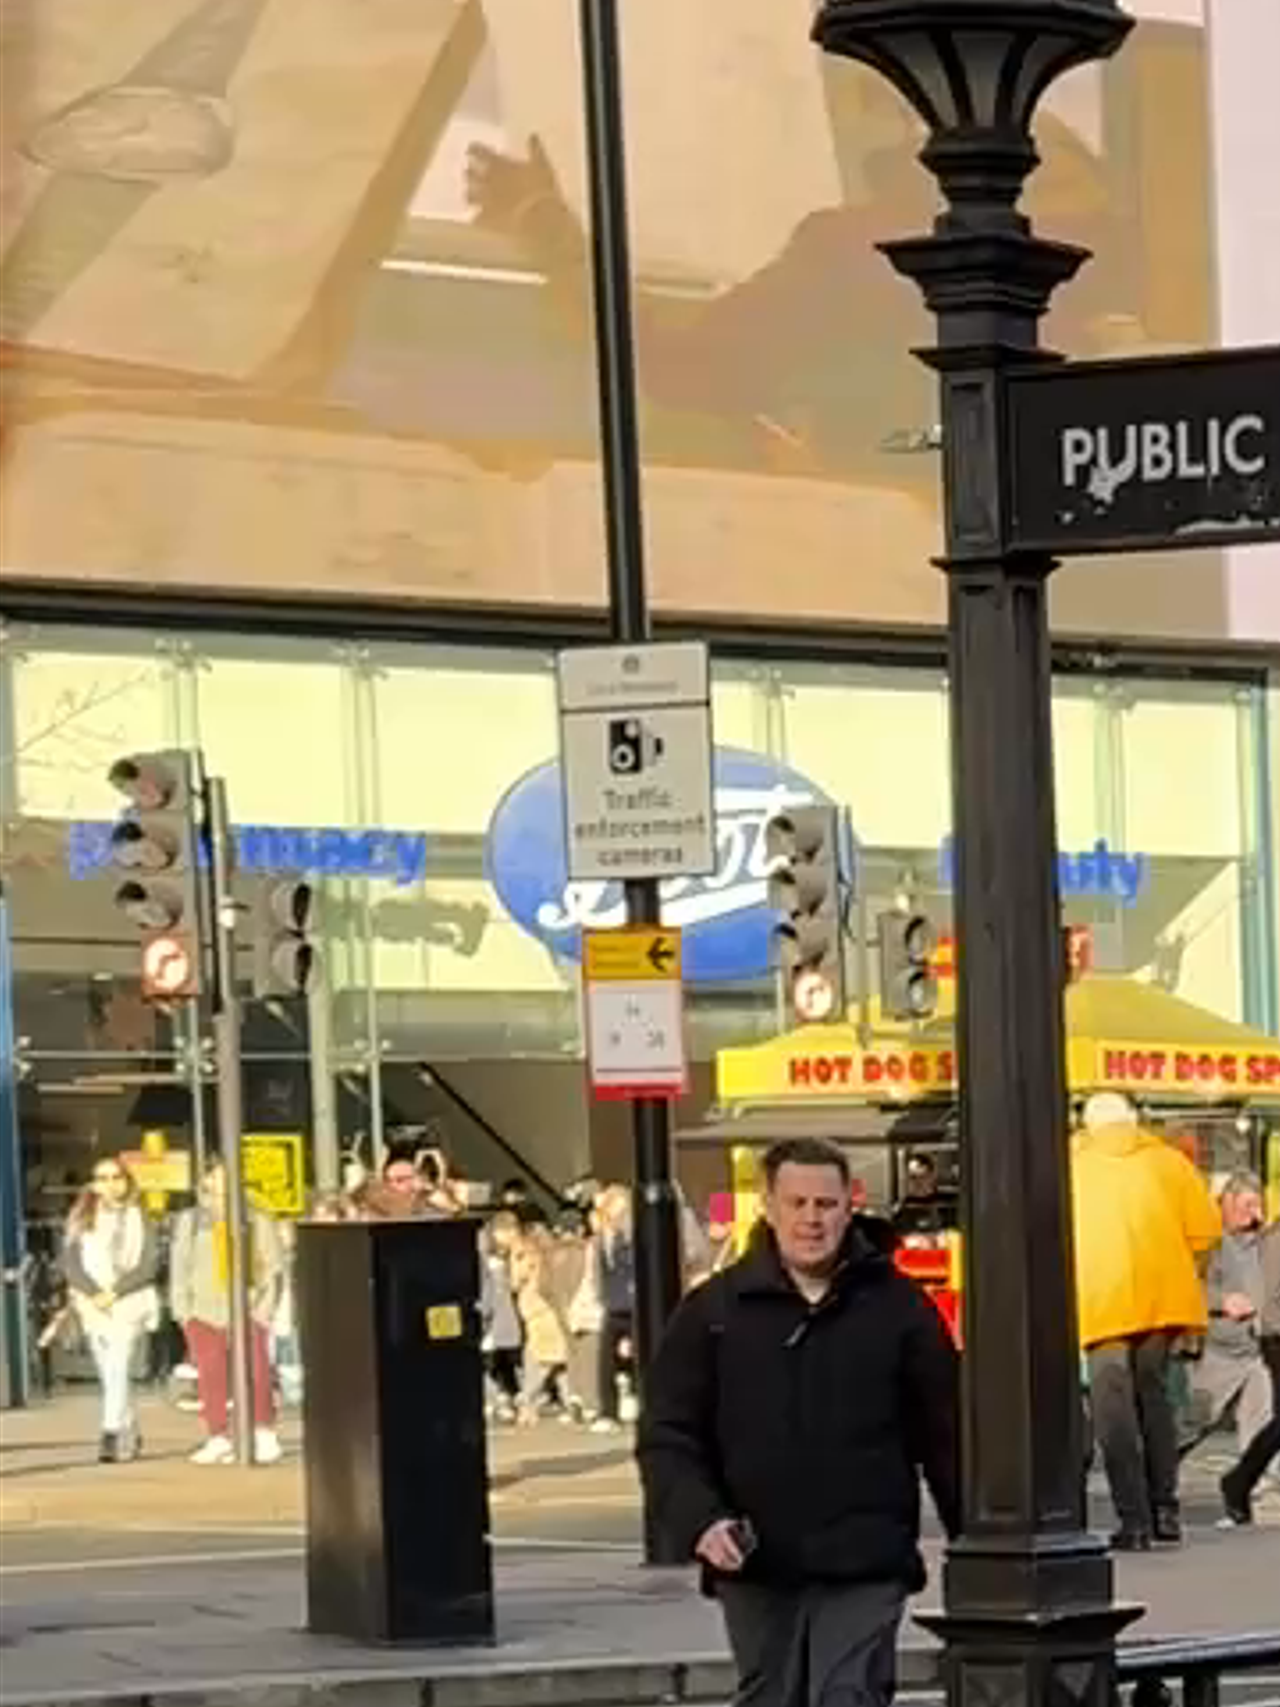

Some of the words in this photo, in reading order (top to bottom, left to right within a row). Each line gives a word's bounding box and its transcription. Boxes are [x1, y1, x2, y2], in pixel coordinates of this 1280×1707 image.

[1062, 412, 1266, 489] PUBLIC
[604, 787, 672, 811] Traffic
[574, 811, 706, 839] enforcement
[598, 845, 683, 868] cameras
[790, 1055, 852, 1086] HOT
[862, 1053, 928, 1084] DOG
[1104, 1050, 1166, 1081] HOT
[1174, 1052, 1238, 1084] DOG
